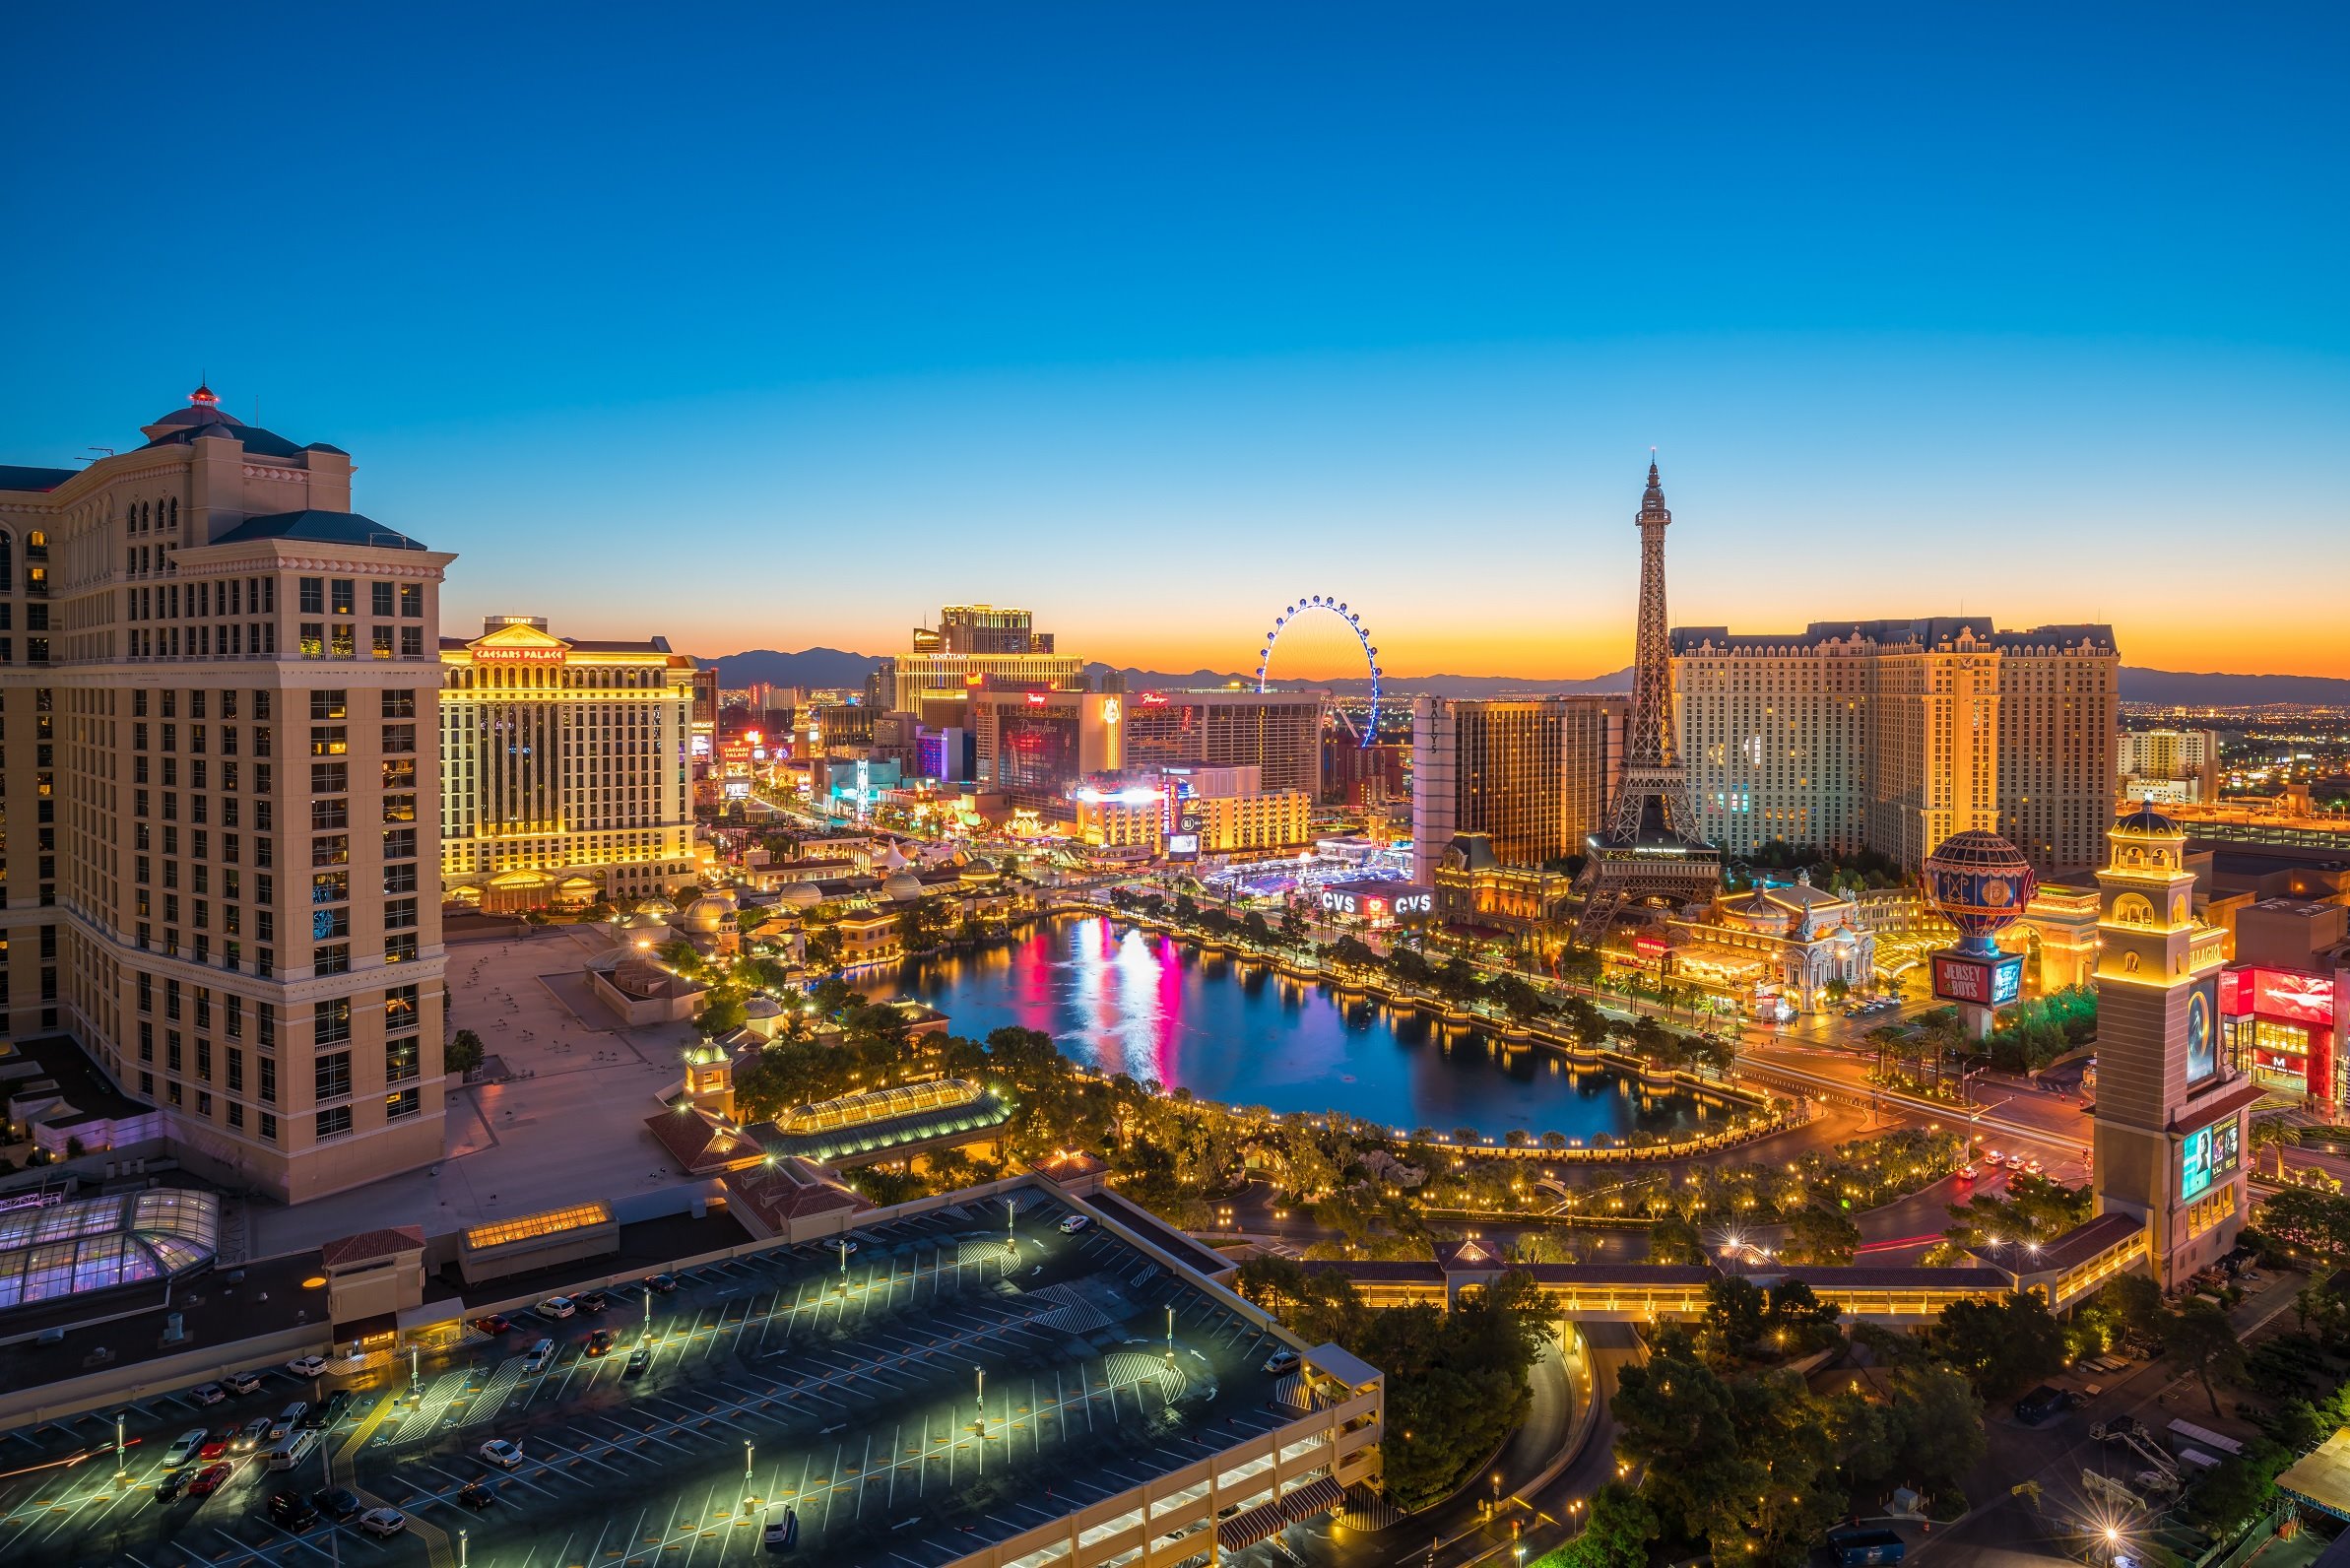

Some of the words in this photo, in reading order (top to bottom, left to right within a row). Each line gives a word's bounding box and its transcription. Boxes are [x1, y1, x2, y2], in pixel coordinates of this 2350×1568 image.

[477, 650, 520, 659] CAESARS
[524, 650, 562, 659] PALACE
[1322, 892, 1355, 913] CVS
[1396, 894, 1431, 914] CVS
[1943, 963, 1981, 983] JERSEY
[1951, 980, 1978, 998] BOYS
[2273, 1056, 2285, 1068] M
